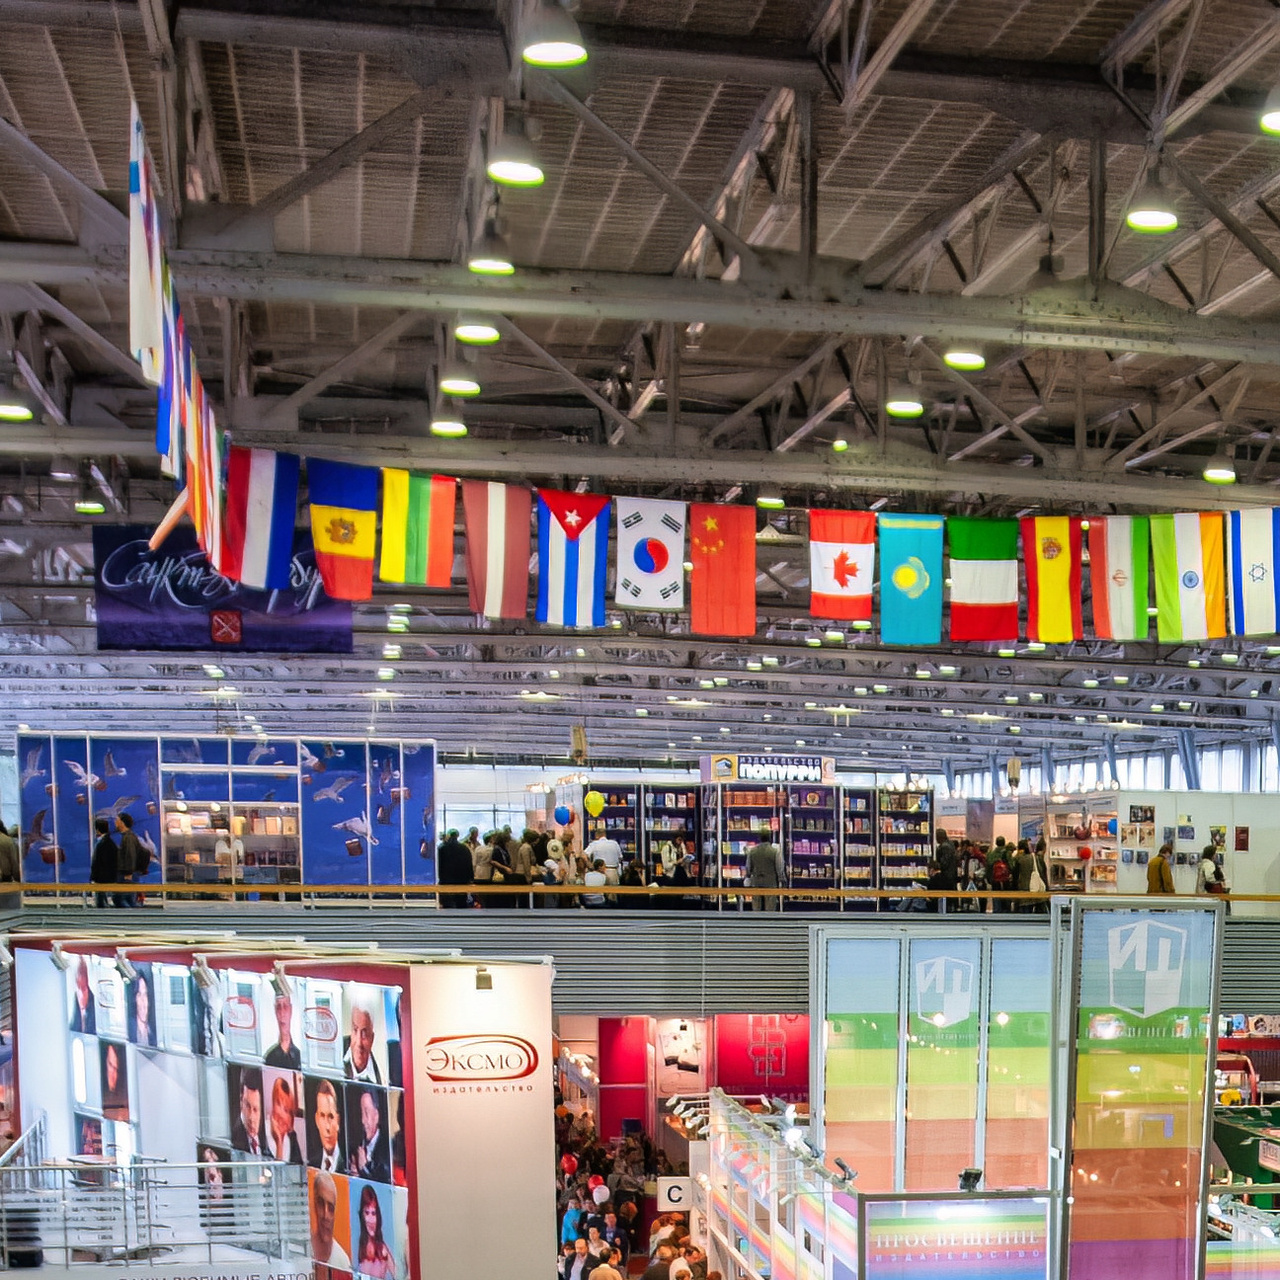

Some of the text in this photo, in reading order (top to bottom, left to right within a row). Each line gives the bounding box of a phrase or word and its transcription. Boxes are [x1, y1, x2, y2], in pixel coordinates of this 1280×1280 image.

[739, 763, 821, 780] ПОПУРРИ
[432, 1084, 534, 1095] издательство
[876, 1230, 1040, 1248] ПРОСВЕЩЕНИЕ
[875, 1250, 1040, 1262] ИЗДАТЕЛЬСТВО
